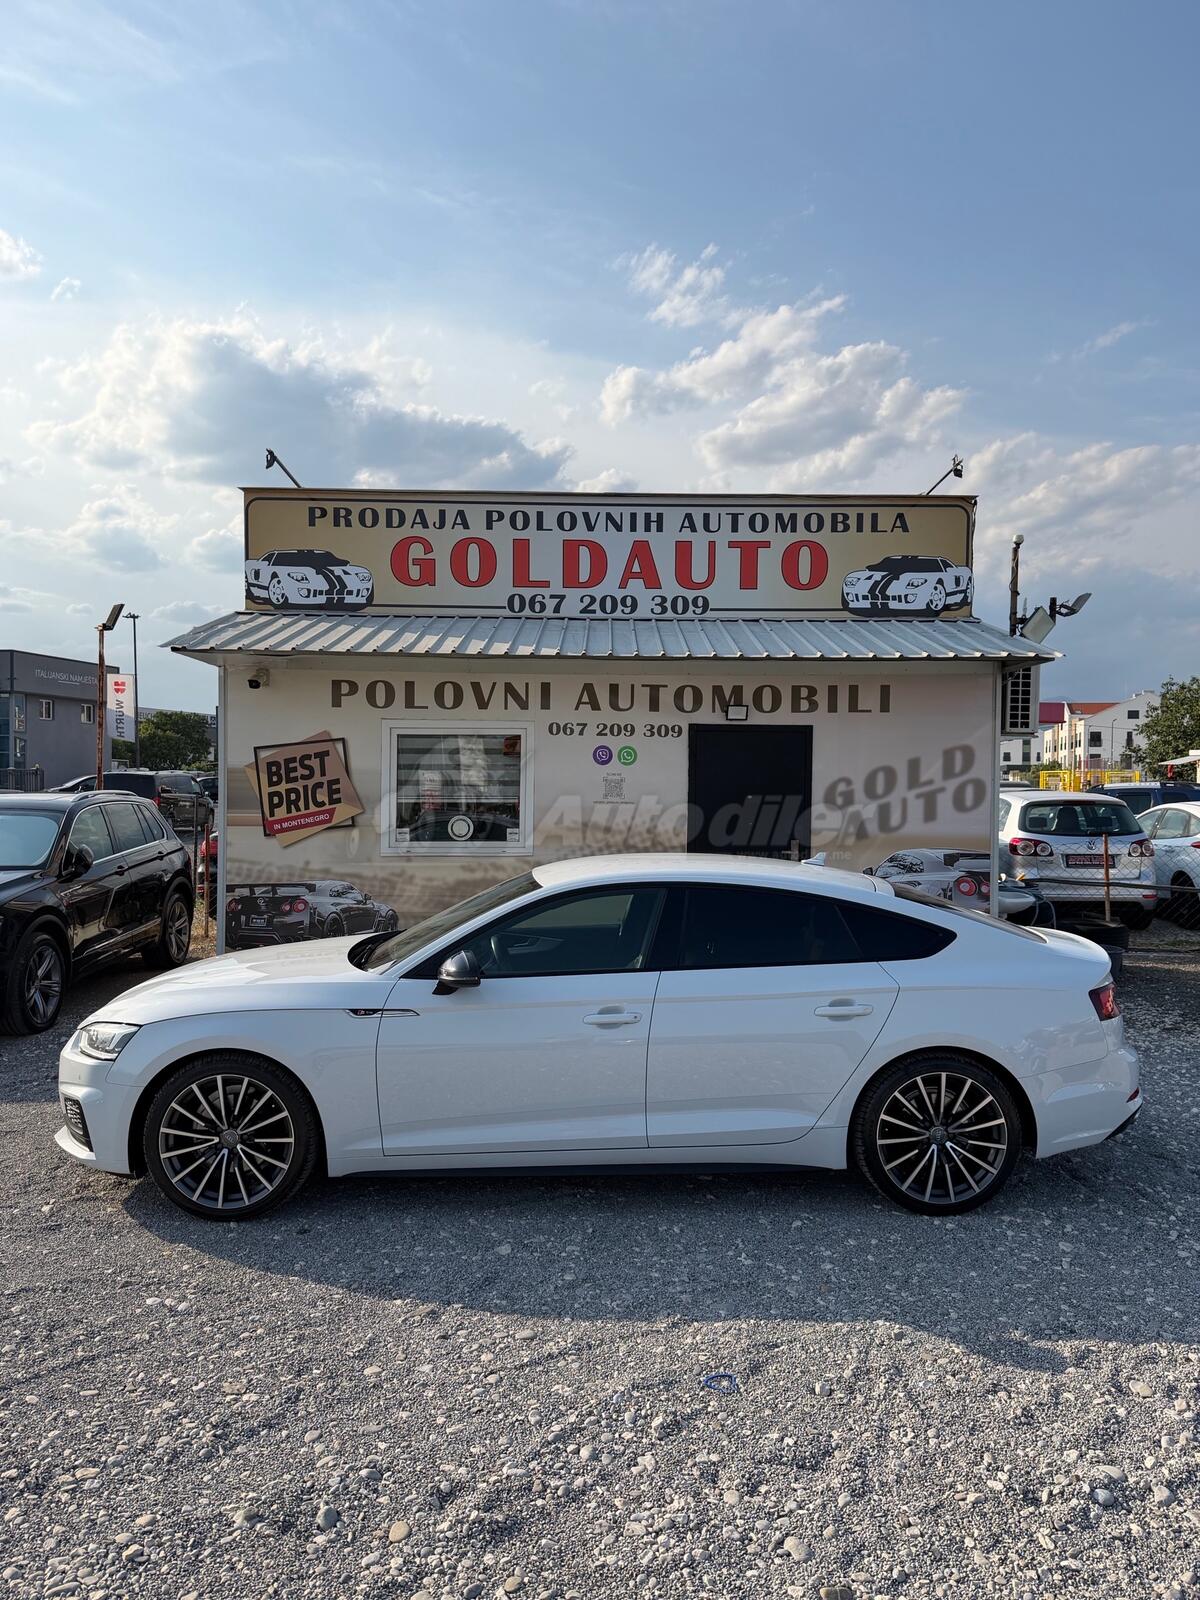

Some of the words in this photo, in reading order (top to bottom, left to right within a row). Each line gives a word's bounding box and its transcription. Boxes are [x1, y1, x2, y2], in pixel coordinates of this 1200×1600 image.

[308, 506, 471, 530] PRODAJA
[485, 510, 664, 533] POLOVNIH
[678, 512, 910, 534] AUTOMOBILA
[390, 536, 829, 590] GOLDAUTO
[507, 593, 566, 615] 067
[579, 594, 639, 616] 209
[651, 594, 711, 616] 309
[331, 679, 552, 712] POLOVNI
[574, 682, 892, 714] AUTOMOBILI
[548, 721, 588, 737] 067
[595, 722, 636, 738] 209
[642, 723, 684, 739] 309
[266, 750, 330, 788] BEST
[823, 743, 976, 812] GOLD
[267, 778, 342, 818] PRICE
[838, 777, 988, 845] AUTO
[273, 822, 281, 830] IN
[282, 813, 330, 828] MONTENEGRO
